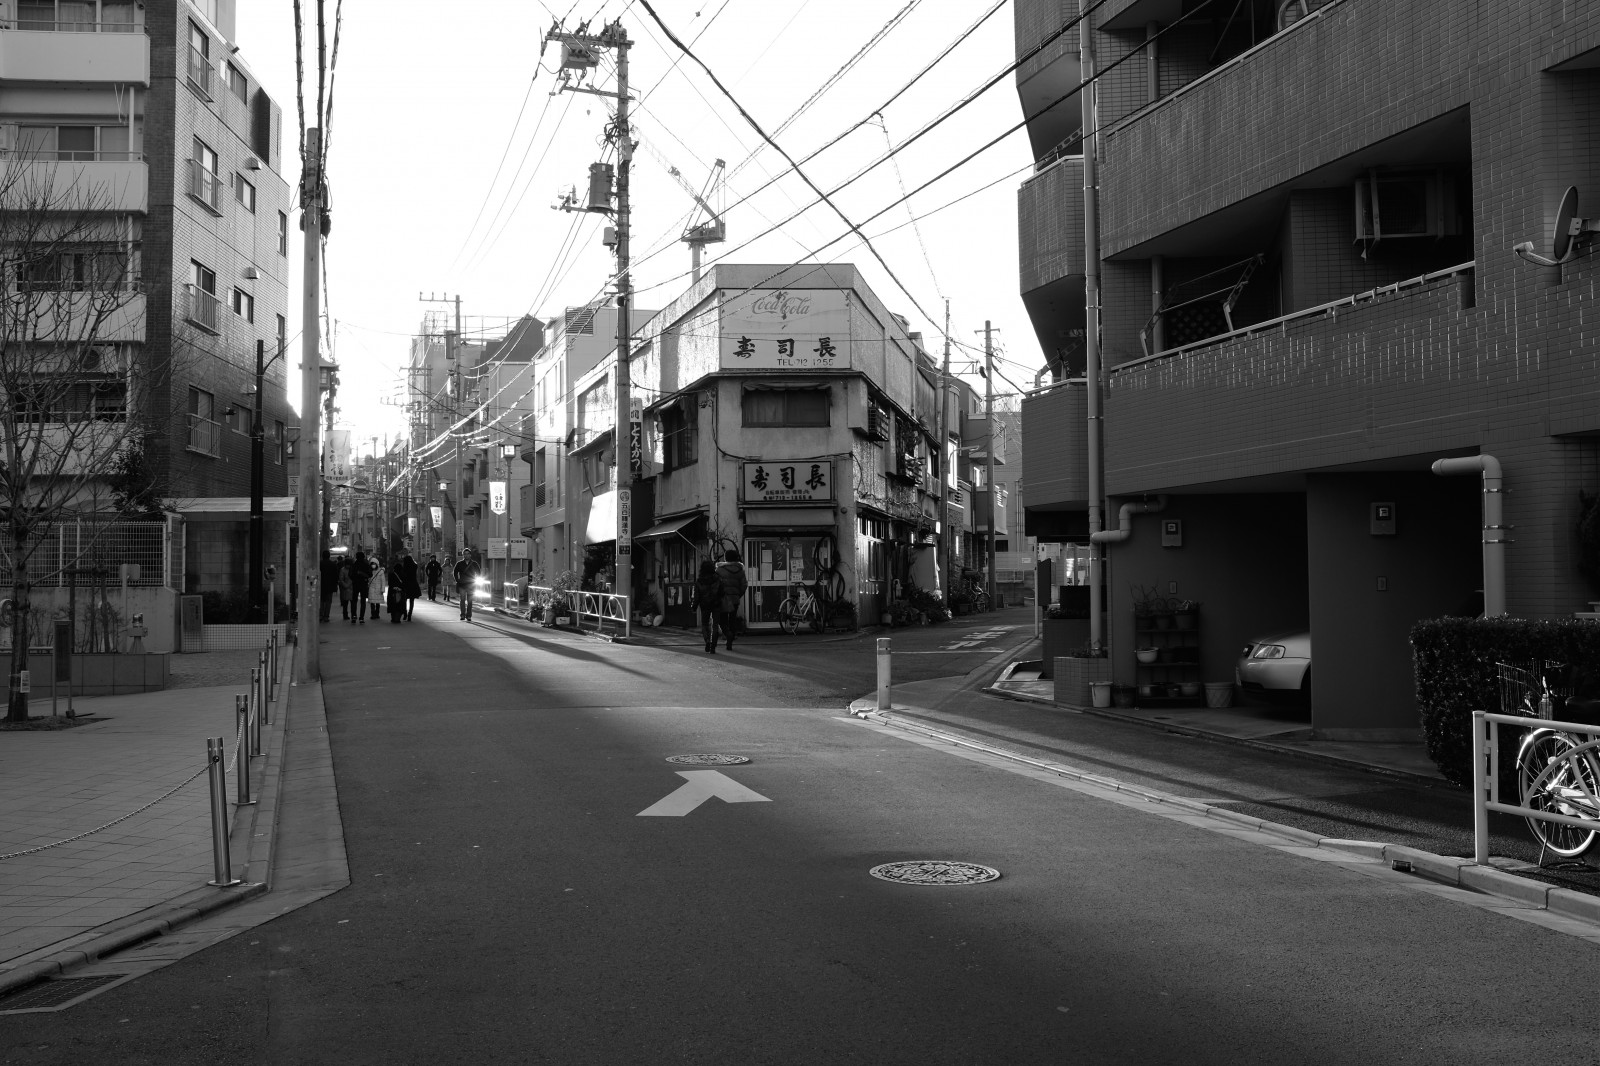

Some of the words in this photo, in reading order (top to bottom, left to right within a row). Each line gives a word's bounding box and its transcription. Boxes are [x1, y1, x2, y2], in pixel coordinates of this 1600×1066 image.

[733, 336, 837, 359] 寿司長
[776, 358, 794, 367] TEL
[631, 422, 642, 470] とんかつ
[750, 464, 826, 492] 寿司長
